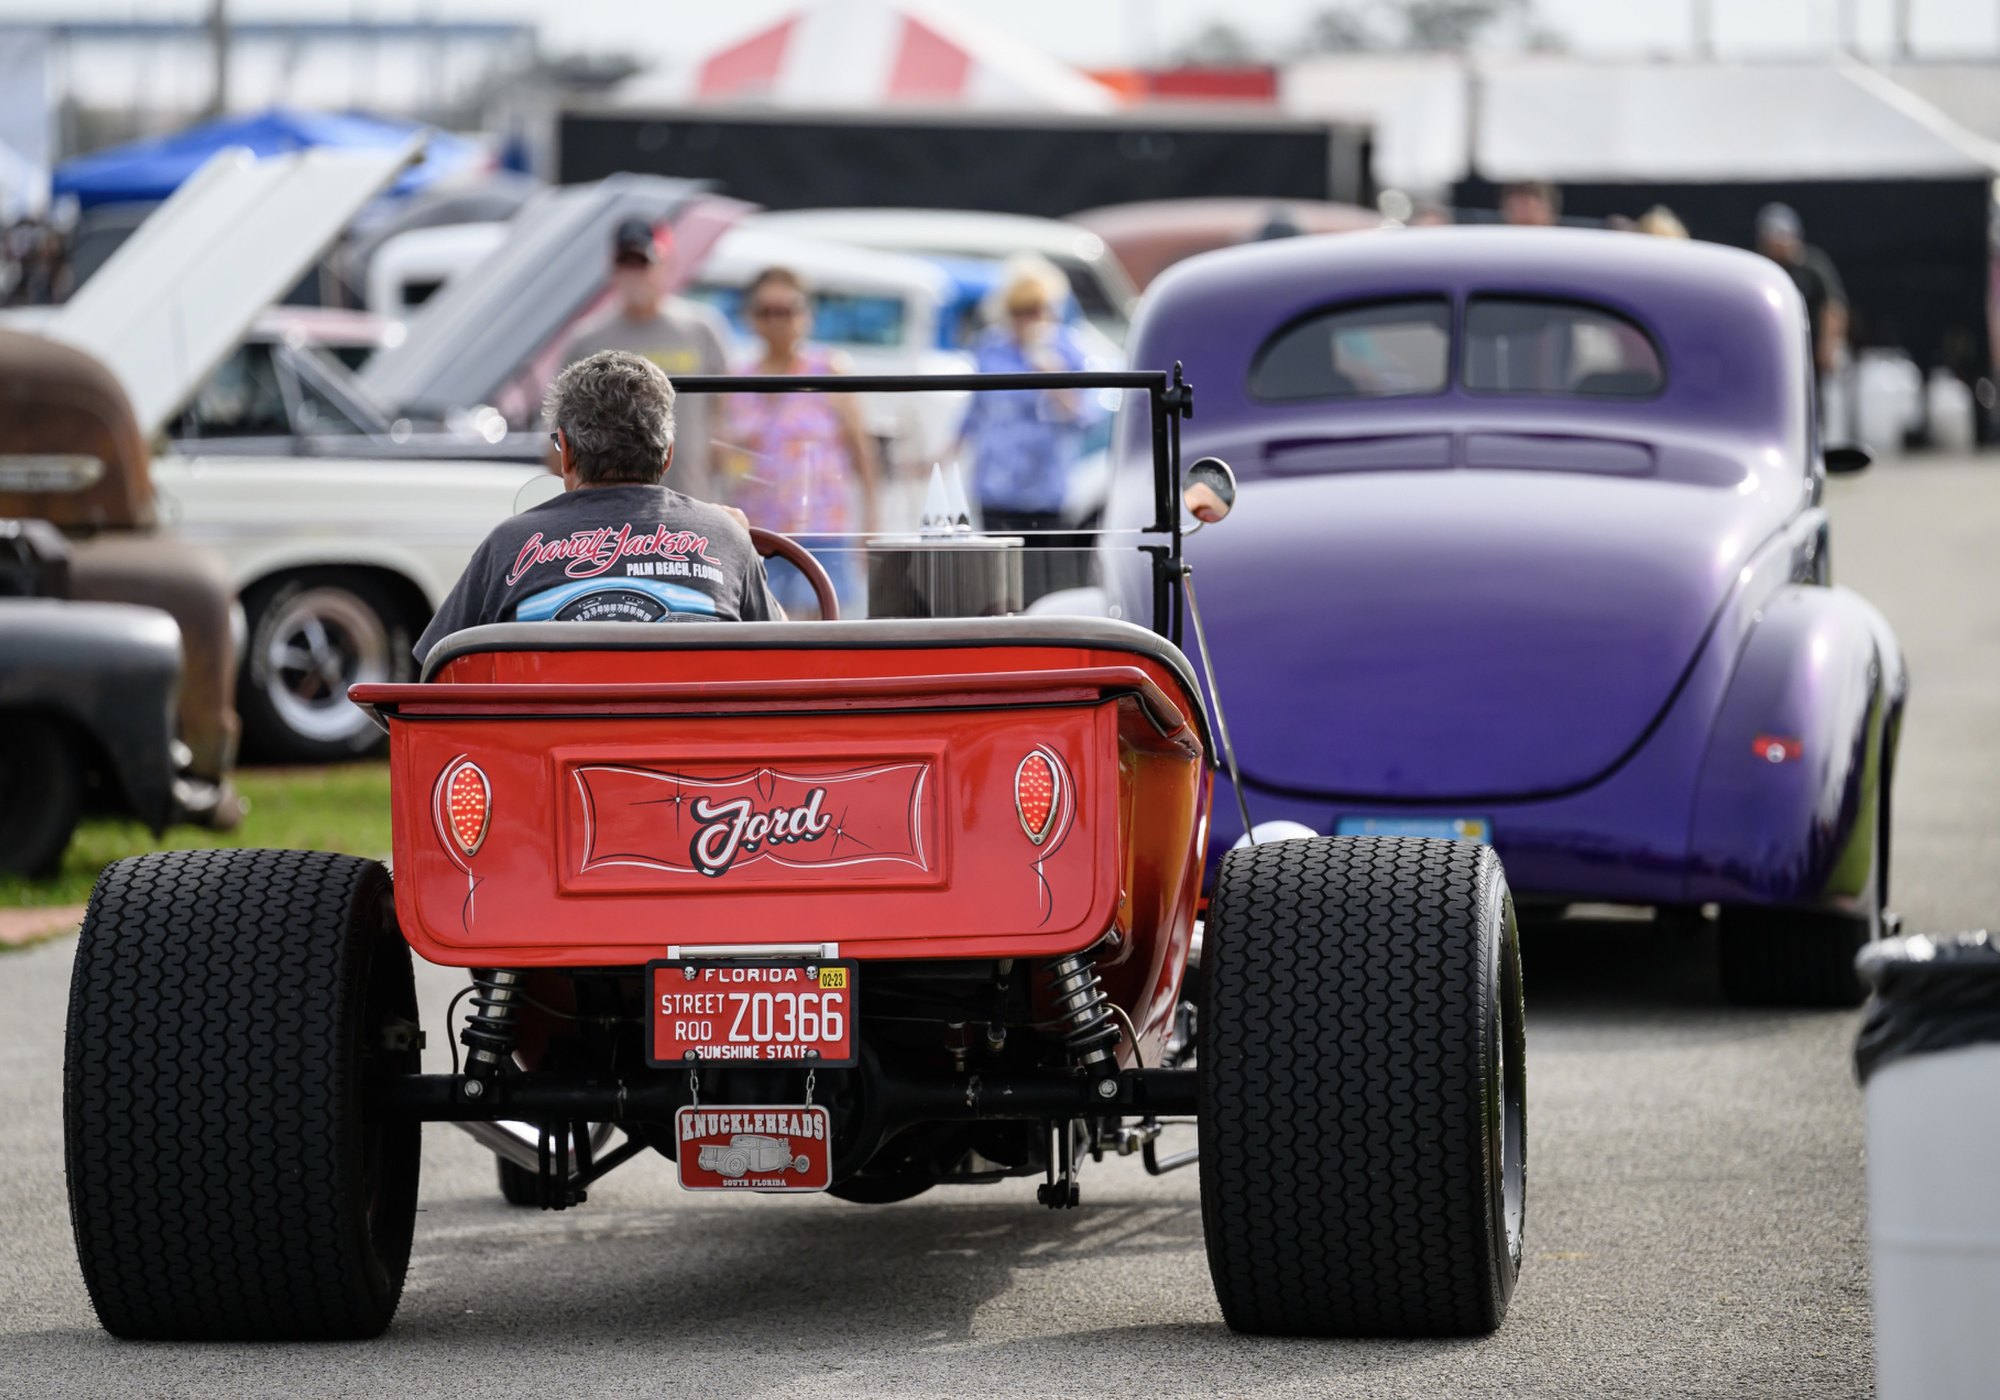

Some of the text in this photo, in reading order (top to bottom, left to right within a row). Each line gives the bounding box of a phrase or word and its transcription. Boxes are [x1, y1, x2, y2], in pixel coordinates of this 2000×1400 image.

[626, 562, 655, 577] PALM
[655, 561, 692, 578] BEACH,
[690, 785, 832, 877] Ford
[704, 968, 798, 983] FLORIDA
[822, 973, 843, 987] 02-23
[661, 993, 725, 1015] STREET
[728, 993, 843, 1042] Z0366
[675, 1021, 712, 1041] ROD
[695, 1045, 760, 1059] SUNSHINE
[681, 1113, 824, 1141] KNUCKLEHEADS
[722, 1179, 787, 1187] SOUTH FLORIDA
